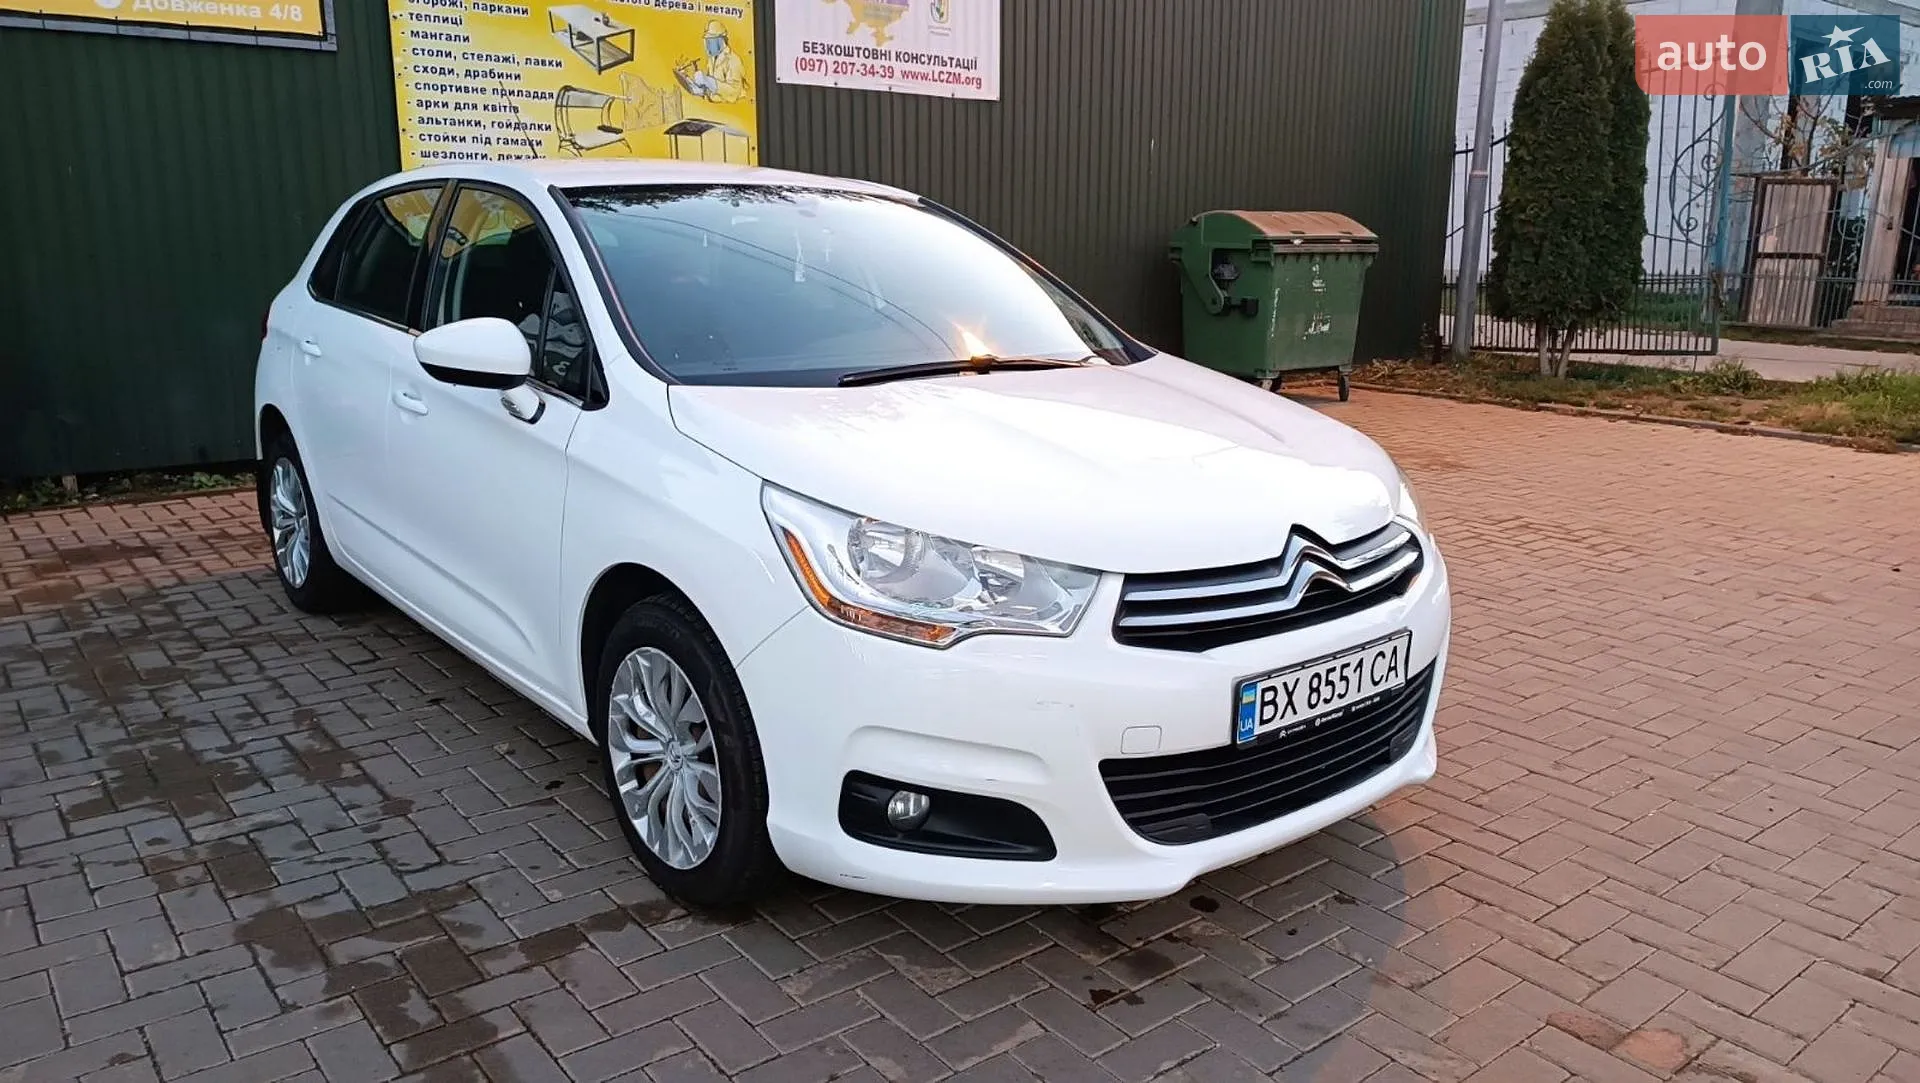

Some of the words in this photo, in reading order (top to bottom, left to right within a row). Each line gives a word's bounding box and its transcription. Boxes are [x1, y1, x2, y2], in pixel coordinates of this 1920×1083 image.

[132, 0, 262, 18] Довженка
[268, 4, 304, 22] 4/8
[473, 3, 529, 16] паркани
[705, 6, 743, 18] металу
[408, 12, 463, 27] теплиці
[410, 29, 470, 43] мангали
[412, 47, 457, 61] столи,
[462, 51, 520, 67] стелажі,
[525, 57, 563, 69] лавки
[802, 41, 891, 62] БЕЗКОШТОВНІ
[895, 51, 978, 71] КОНСУЛЬТАЦІЇ
[413, 64, 459, 78] сходи,
[464, 68, 521, 82] драбини
[794, 56, 828, 76] (097)
[832, 61, 895, 80] 207-34-39
[900, 69, 982, 90] www.LCZM.org
[415, 81, 487, 96] спортивне
[492, 88, 554, 100] приладдя
[416, 99, 449, 110] арки
[454, 102, 478, 112] для
[483, 104, 520, 114] квітів
[417, 116, 486, 130] альтанки,
[491, 118, 552, 132] гойдалки
[418, 131, 467, 145] стойки
[472, 133, 492, 146] під
[496, 137, 543, 147] гамаки
[1259, 678, 1300, 726] BX
[1307, 656, 1364, 710] 8551
[1370, 645, 1399, 687] CA
[1240, 719, 1254, 732] UA
